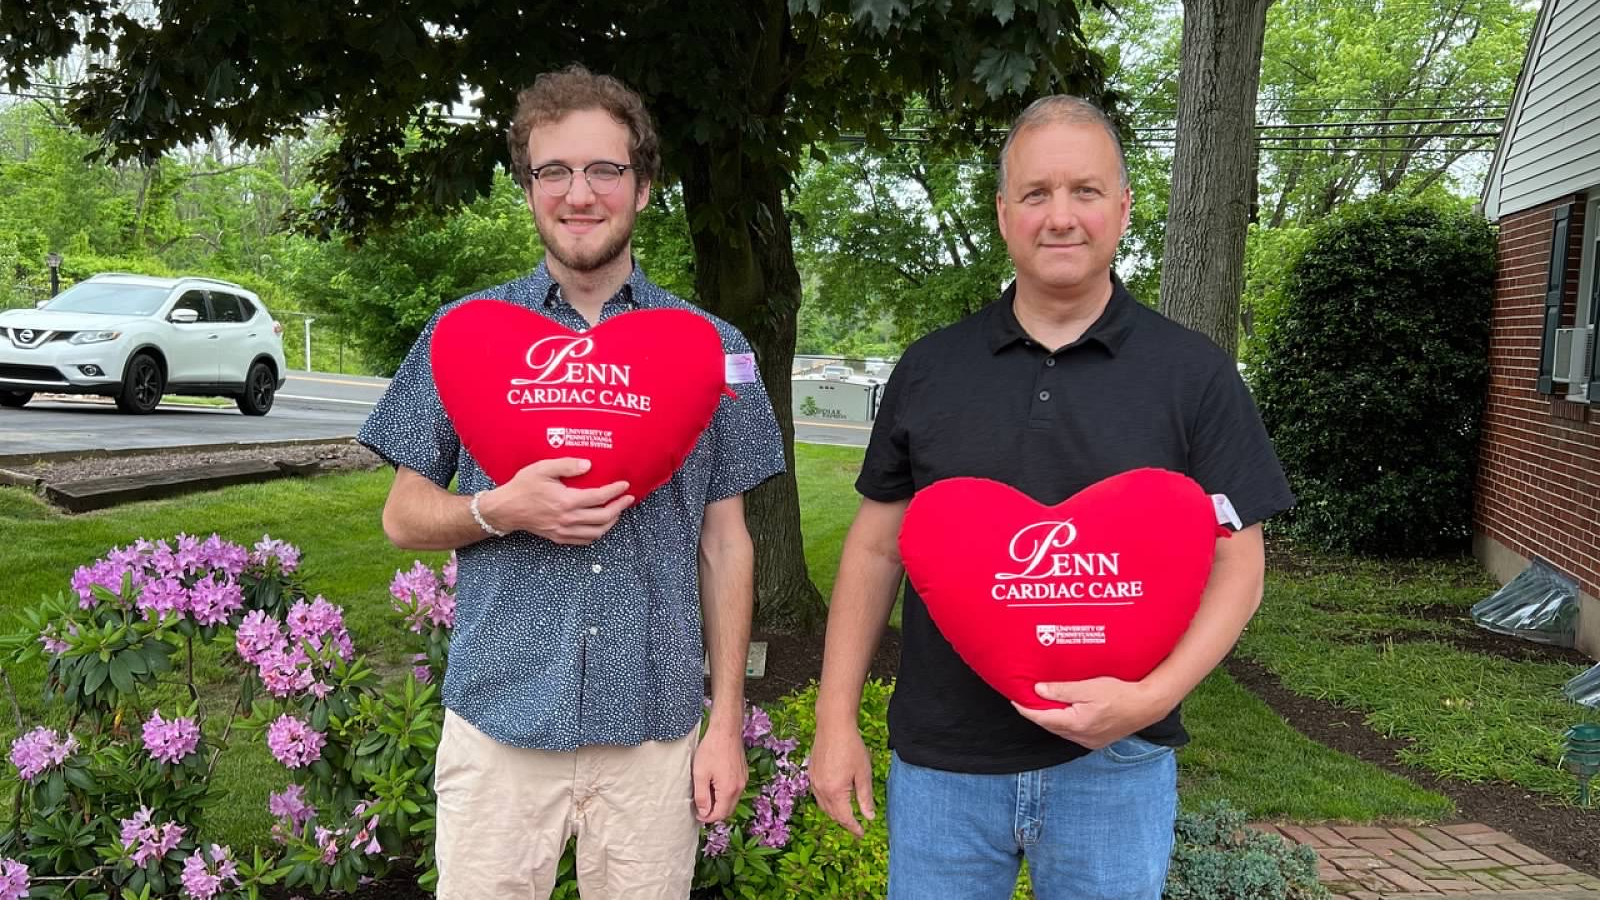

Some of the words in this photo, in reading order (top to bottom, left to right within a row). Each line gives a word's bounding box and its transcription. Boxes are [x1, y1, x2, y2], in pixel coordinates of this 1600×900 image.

[510, 335, 631, 387] PENN
[507, 388, 596, 405] CARDIAC
[599, 390, 651, 411] CARE
[994, 517, 1120, 579] PENN
[991, 582, 1085, 600] CARDIAC
[1088, 581, 1144, 598] CARE
